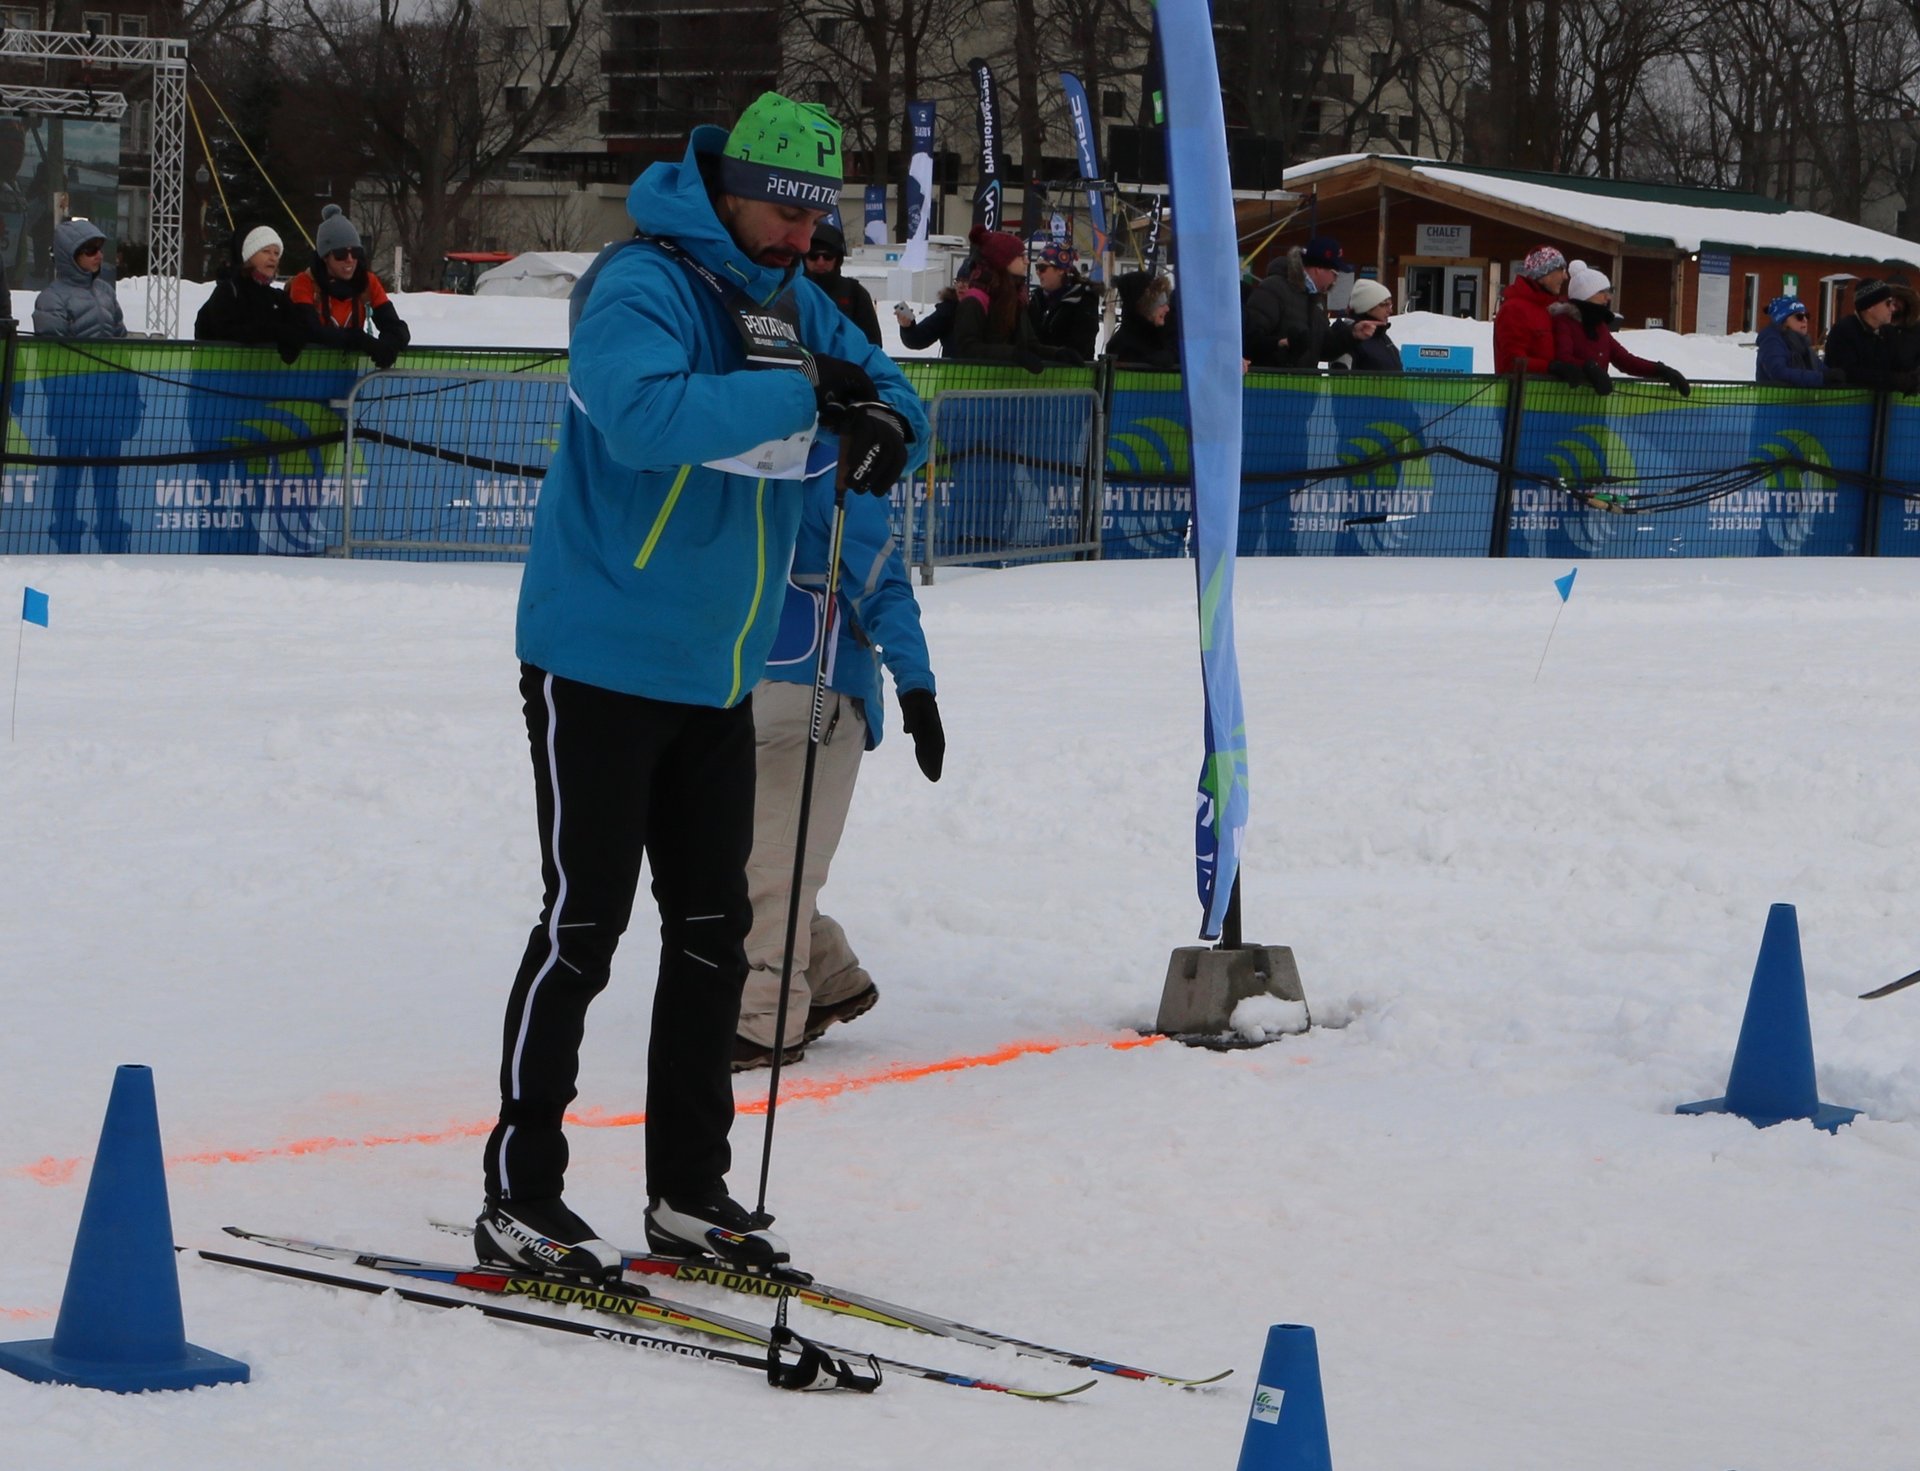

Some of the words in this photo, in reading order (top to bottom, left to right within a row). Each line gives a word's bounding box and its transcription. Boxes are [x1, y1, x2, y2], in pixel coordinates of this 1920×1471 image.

[1426, 226, 1462, 238] CHALET
[853, 449, 877, 480] CRAFT
[495, 1217, 565, 1263] SALOMON
[505, 1279, 637, 1315] SALOMON
[676, 1265, 799, 1299] SALOMON
[593, 1329, 711, 1362] SALOMON
